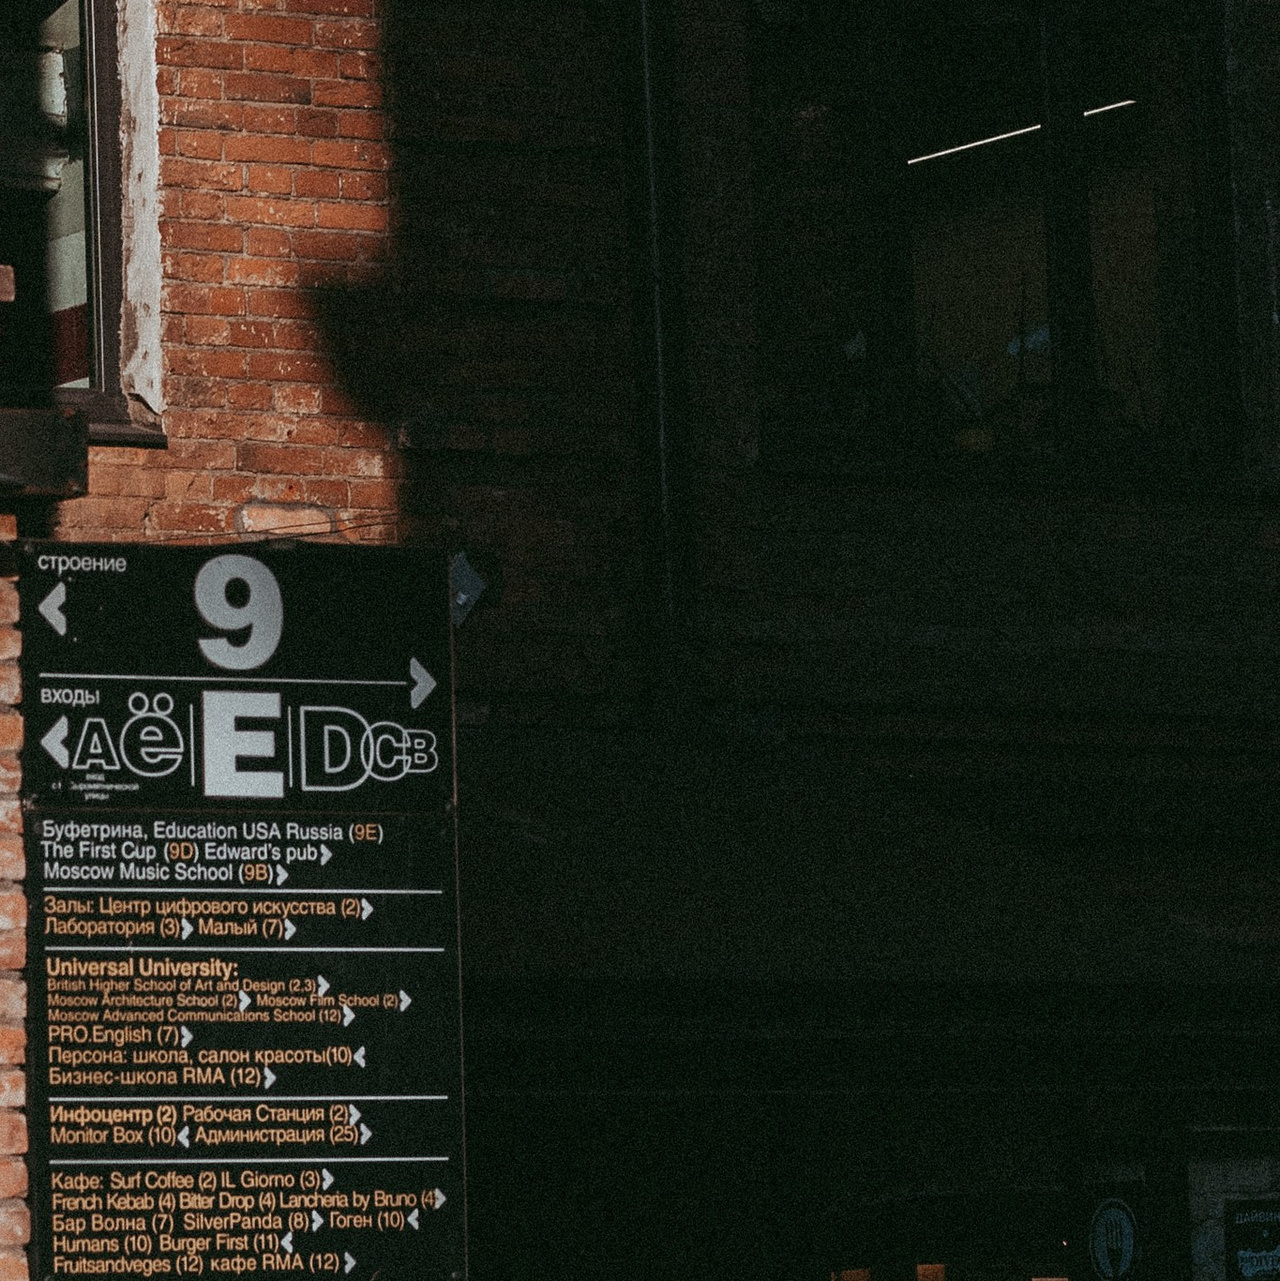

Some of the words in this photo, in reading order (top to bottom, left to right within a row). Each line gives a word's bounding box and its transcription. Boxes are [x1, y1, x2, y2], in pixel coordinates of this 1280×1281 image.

[37, 555, 127, 575] строение
[195, 555, 283, 670] 9
[41, 688, 100, 706] входы
[202, 691, 284, 797] E
[41, 820, 147, 843] Буфетрина,
[154, 822, 237, 839] Education
[243, 822, 281, 840] USA
[286, 822, 343, 840] Russia
[349, 824, 383, 844] (9E)
[40, 839, 74, 858] The
[79, 839, 116, 859] First
[120, 841, 158, 864] Cup
[164, 842, 200, 865] (9D)
[205, 842, 281, 860] Edward's
[286, 844, 318, 864] pub
[44, 862, 114, 879] Moscow
[120, 861, 169, 880] Music
[175, 861, 233, 881] School
[238, 864, 273, 884] (9B)
[44, 895, 93, 914] Залы:
[99, 897, 151, 917] Центр
[156, 898, 248, 920] цифрового
[253, 901, 336, 919] искусства
[341, 898, 362, 918] (2)
[45, 916, 155, 938] Лаборатория
[160, 918, 182, 938] (3)
[199, 918, 257, 935] Малый
[262, 916, 285, 938] (7)
[46, 958, 134, 976] Universal
[137, 958, 238, 980] University:
[47, 977, 86, 991] British
[89, 979, 130, 996] Higher
[134, 978, 176, 991] School
[179, 979, 191, 992] of
[195, 979, 213, 991] Art
[216, 977, 243, 994] and
[242, 979, 285, 997] Design
[47, 994, 98, 1006] Moscow
[102, 992, 173, 1009] Architecture
[177, 993, 218, 1007] School
[222, 994, 238, 1008] (2)
[256, 993, 306, 1007] Moscow
[338, 994, 379, 1009] School
[383, 994, 400, 1008] (2)
[48, 1009, 99, 1021] Moscow
[103, 1009, 164, 1022] Advanced
[167, 1008, 270, 1022] Communications
[273, 1008, 315, 1022] School
[319, 1009, 341, 1023] (12)
[48, 1025, 151, 1048] PRO.English
[157, 1026, 179, 1045] (7)
[48, 1046, 127, 1068] Персона:
[133, 1050, 193, 1064] школа,
[198, 1050, 250, 1063] салон
[49, 1065, 177, 1085] Бизнес-школа
[183, 1067, 225, 1083] RMA
[230, 1067, 261, 1087] (12)
[50, 1106, 153, 1128] Инфоцентр
[156, 1105, 177, 1129] (2)
[183, 1105, 251, 1122] Рабочая
[256, 1104, 324, 1123] Станция
[329, 1104, 350, 1125] (2)
[51, 1126, 108, 1143] Monitor
[113, 1126, 143, 1143] Box
[148, 1126, 177, 1146] (10)
[195, 1126, 325, 1145] Администрация
[330, 1123, 358, 1144] (25)
[52, 1173, 103, 1193] Кафе:
[110, 1172, 141, 1189] Surf
[145, 1171, 194, 1189] Coffee
[198, 1171, 217, 1191] (2)
[221, 1172, 236, 1188] IL
[240, 1170, 295, 1188] Giorno
[300, 1171, 320, 1191] (3)
[52, 1193, 102, 1210] French
[107, 1193, 154, 1210] Kebab
[158, 1193, 176, 1212] (4)
[179, 1192, 215, 1209] Bitter
[219, 1192, 255, 1213] Drop
[259, 1192, 276, 1211] (4)
[280, 1191, 349, 1211] Lancheria
[353, 1191, 370, 1211] by
[374, 1190, 417, 1207] Bruno
[52, 1214, 86, 1233] Бар
[91, 1214, 146, 1231] Волна
[152, 1211, 174, 1235] (7)
[184, 1211, 282, 1230] SilverPanda
[287, 1212, 309, 1234] (8)
[330, 1210, 372, 1228] Гоген
[377, 1211, 405, 1230] (10)
[53, 1236, 119, 1252] Humans
[124, 1235, 152, 1255] (10)
[159, 1232, 211, 1256] Burger
[216, 1233, 249, 1250] First
[253, 1234, 281, 1255] (11)
[54, 1256, 171, 1277] Fruitsandveges
[176, 1254, 203, 1274] (12)
[211, 1255, 257, 1274] кафе
[262, 1252, 304, 1270] RMA
[309, 1253, 339, 1273] (12)
